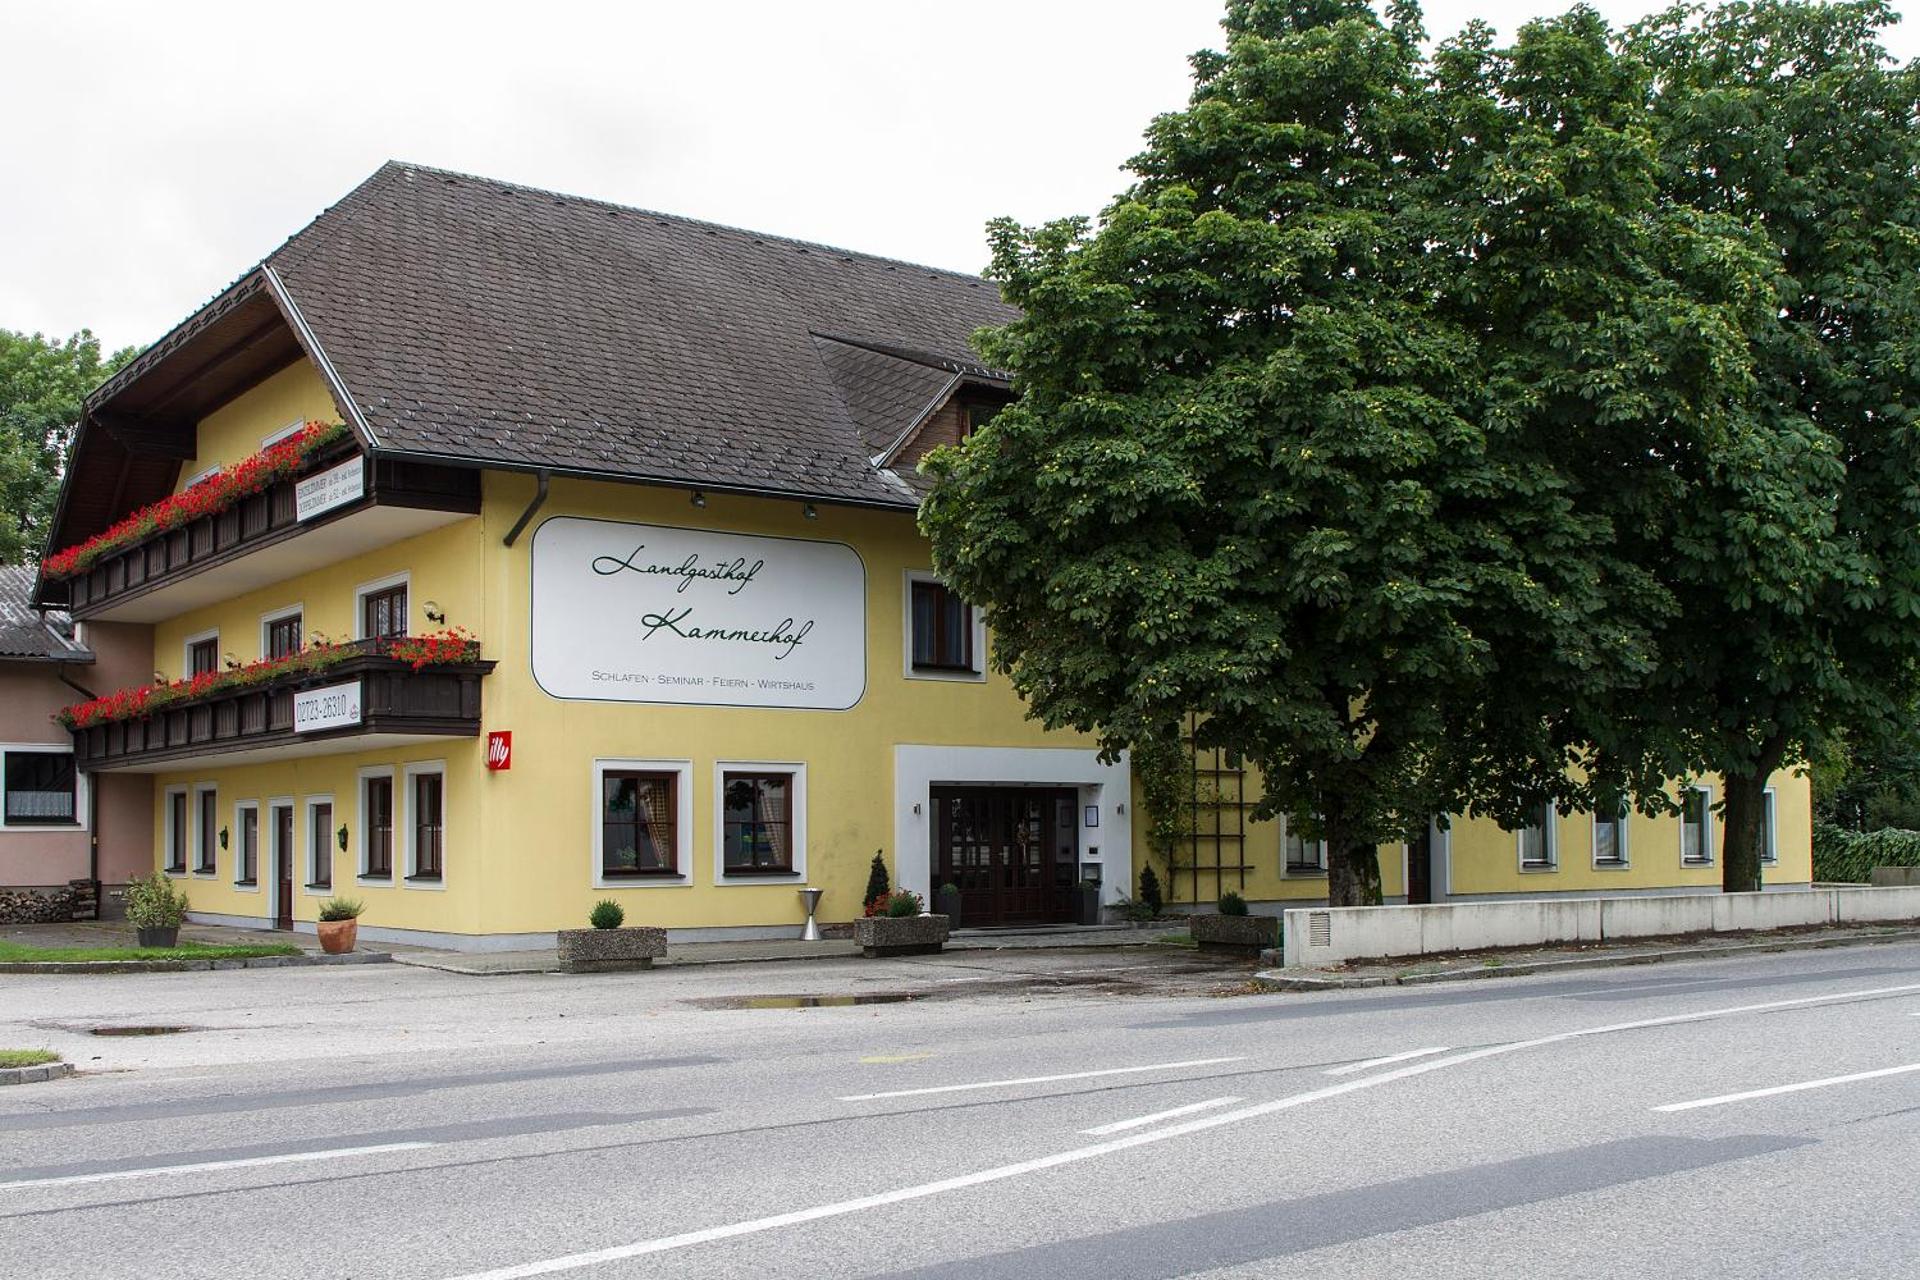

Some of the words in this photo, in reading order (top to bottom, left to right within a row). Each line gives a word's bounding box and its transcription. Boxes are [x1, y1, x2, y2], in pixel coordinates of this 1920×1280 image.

[592, 545, 764, 595] Landgasthof
[641, 608, 814, 660] Kammerhof
[592, 670, 649, 684] SCHLAFEN
[657, 674, 704, 686] SEMINAR
[712, 676, 749, 689] FEIERN
[757, 679, 815, 691] WIRTSHAUS
[489, 736, 509, 768] illy
